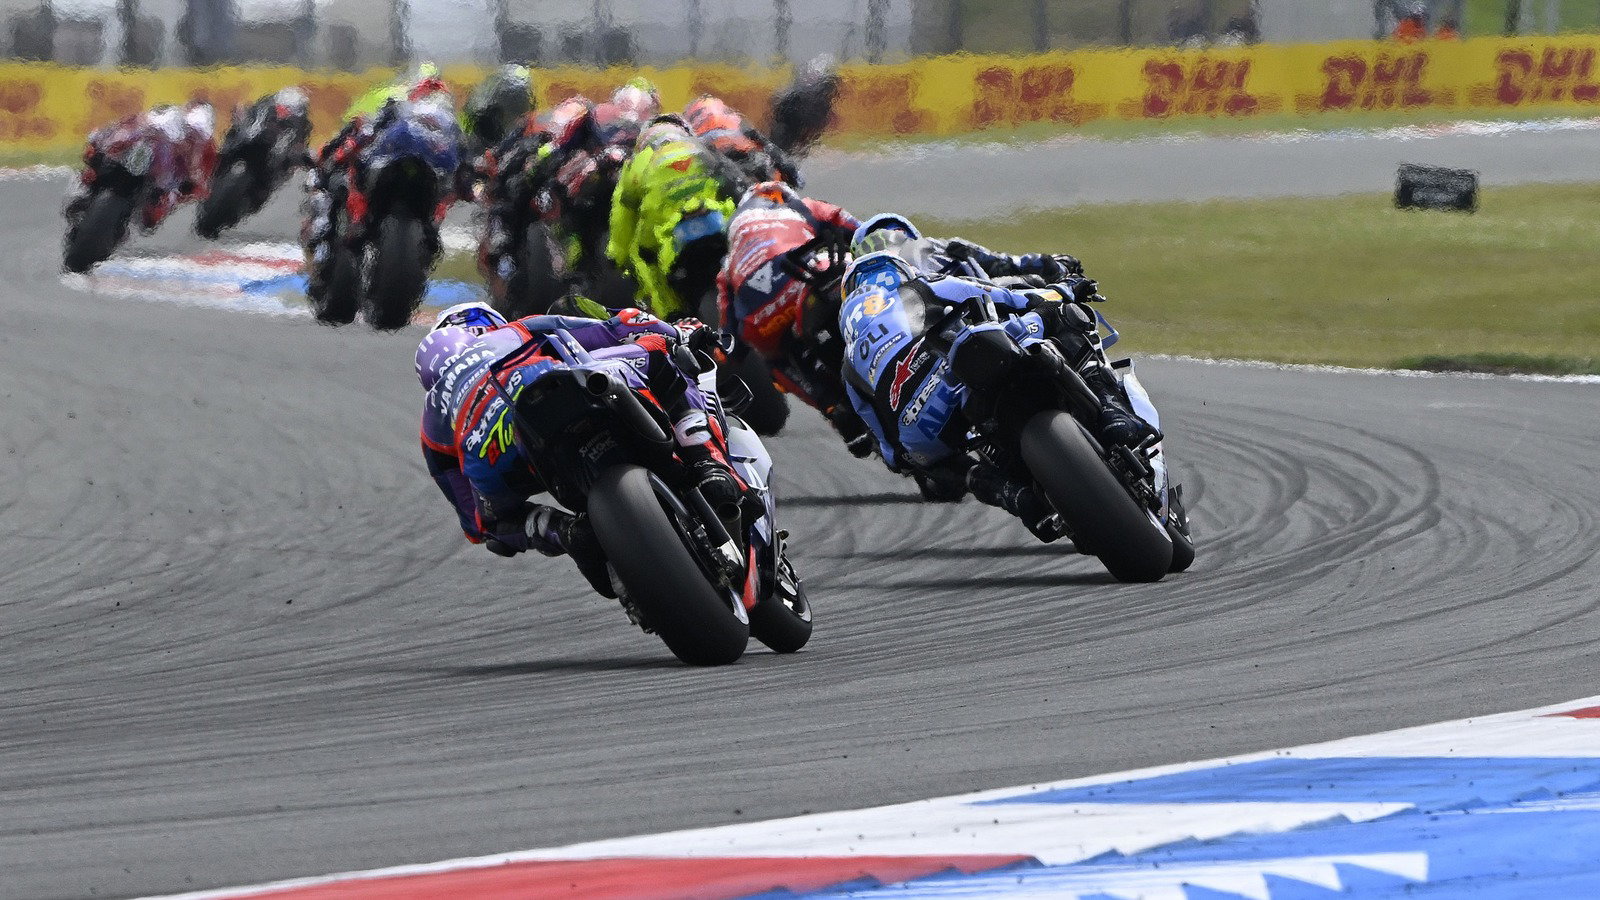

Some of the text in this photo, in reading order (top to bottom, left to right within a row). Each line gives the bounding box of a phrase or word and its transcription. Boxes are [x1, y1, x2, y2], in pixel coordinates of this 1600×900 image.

[1142, 58, 1258, 117] DHL
[1320, 52, 1434, 112] DHL
[1497, 47, 1600, 106] DHL
[440, 349, 496, 415] YAMAHA
[456, 358, 497, 403] MICHELIN
